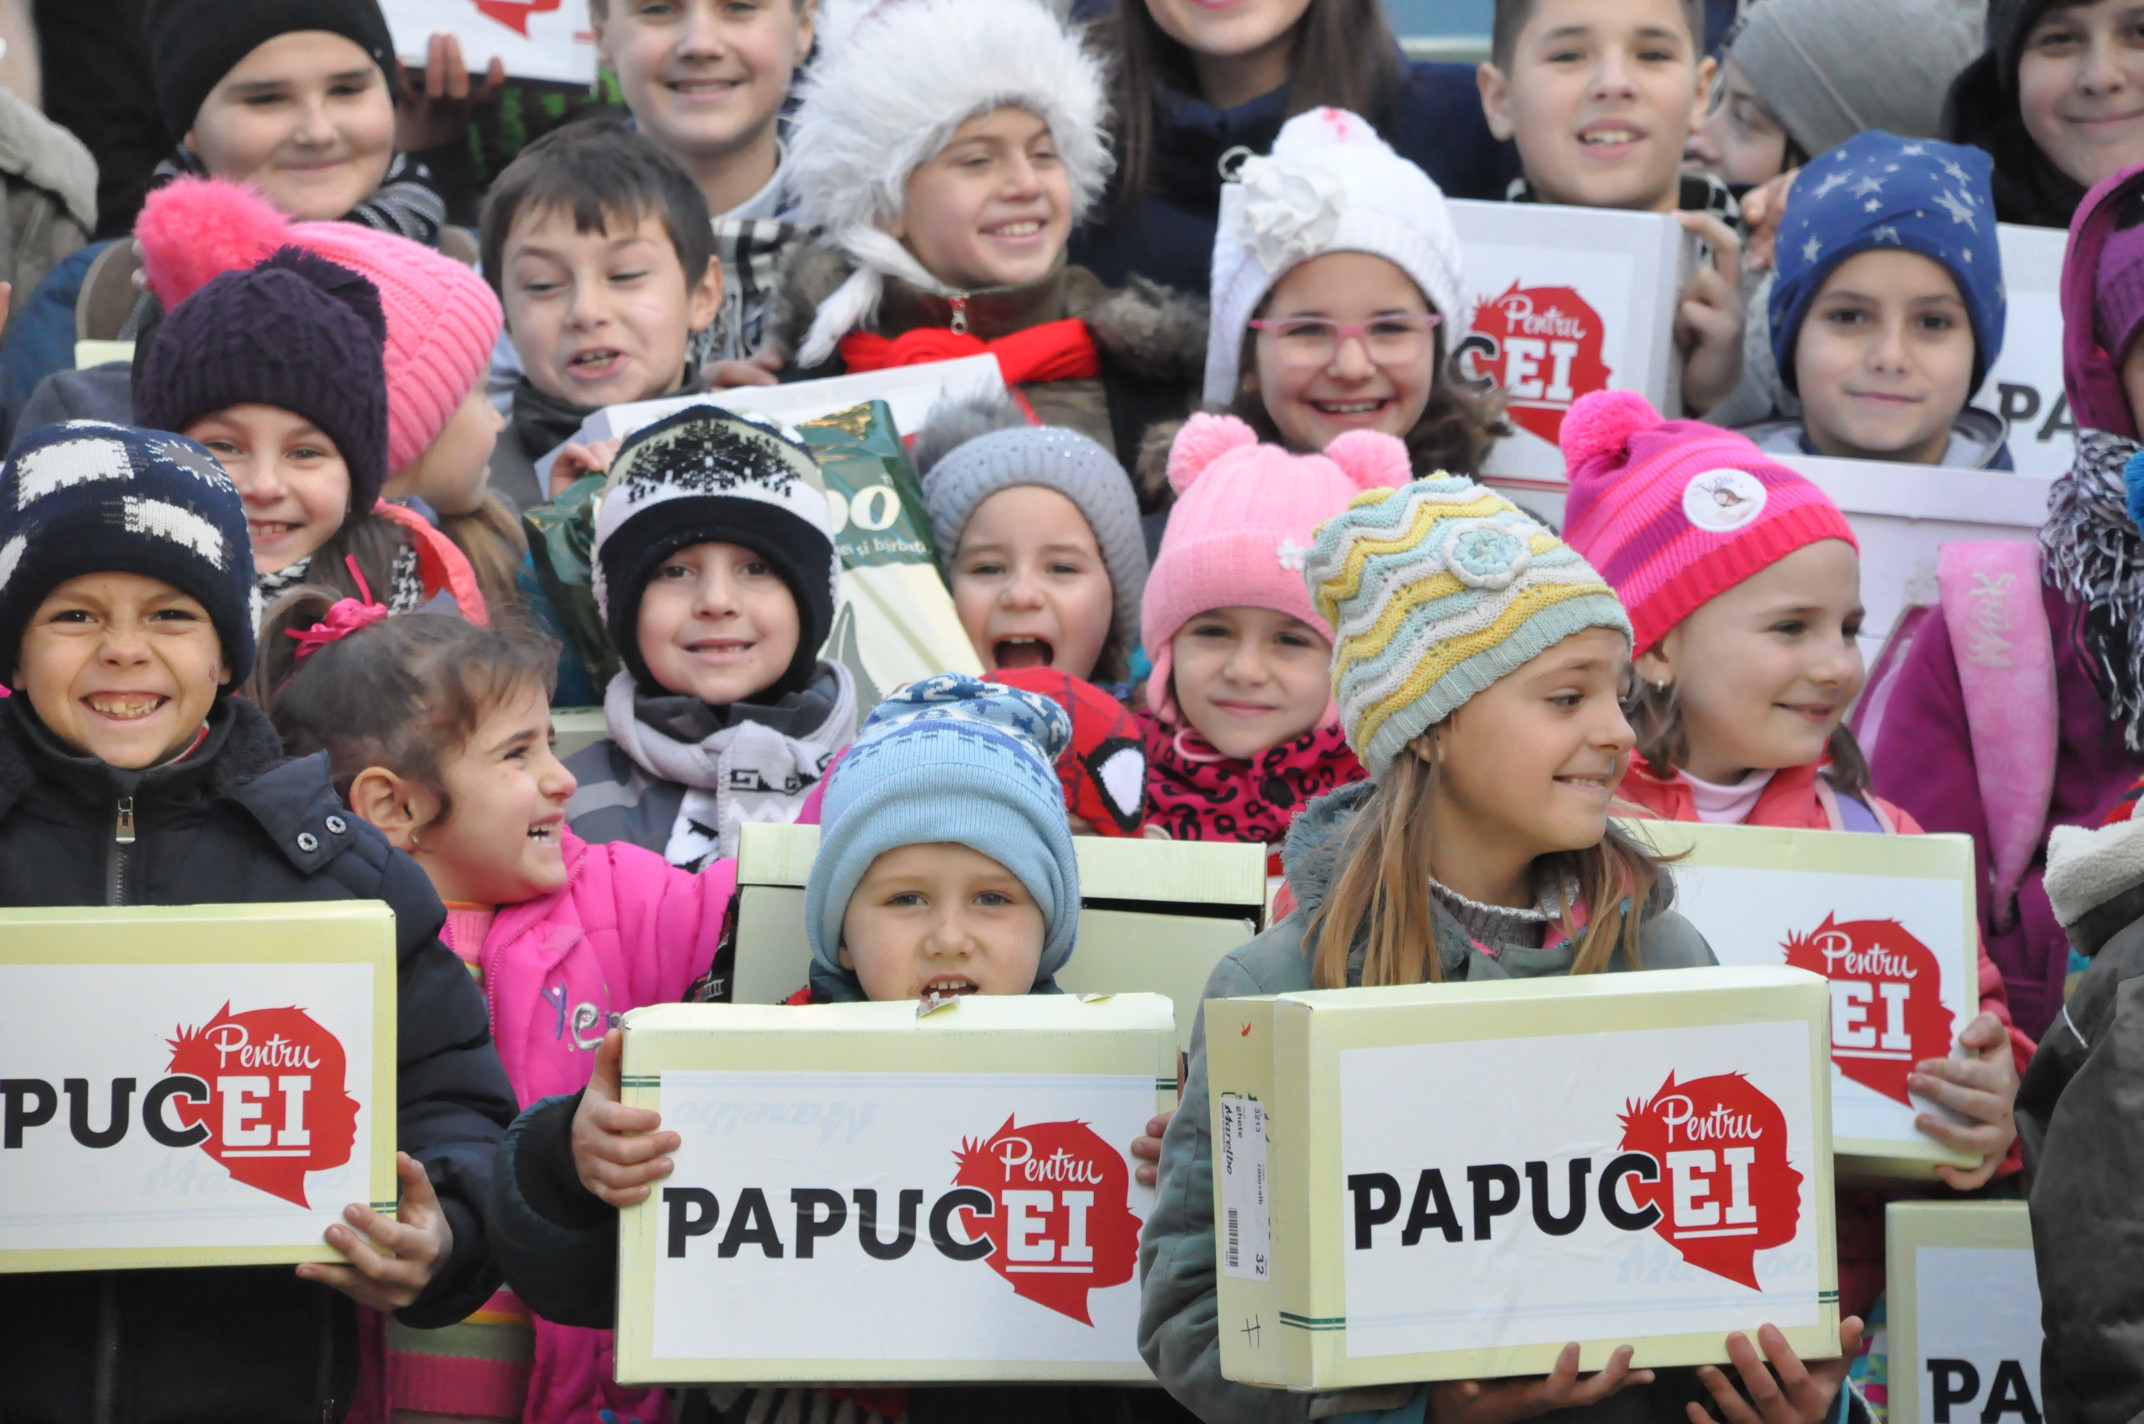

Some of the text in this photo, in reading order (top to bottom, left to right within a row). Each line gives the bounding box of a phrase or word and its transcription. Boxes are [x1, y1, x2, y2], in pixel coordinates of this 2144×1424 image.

[1498, 293, 1587, 339] Pentru
[1813, 930, 1918, 979] Pentru
[205, 1023, 321, 1069] Pentru
[1224, 1104, 1235, 1176] Marelbo
[1234, 1105, 1243, 1139] ghete
[1653, 1094, 1763, 1144] Pentru
[990, 1137, 1104, 1184] Pentru
[1347, 1147, 1758, 1250] PAPUCEI
[662, 1187, 1095, 1261] PAPUCEI
[1255, 1252, 1265, 1276] 32
[1926, 1358, 2042, 1424] PA
